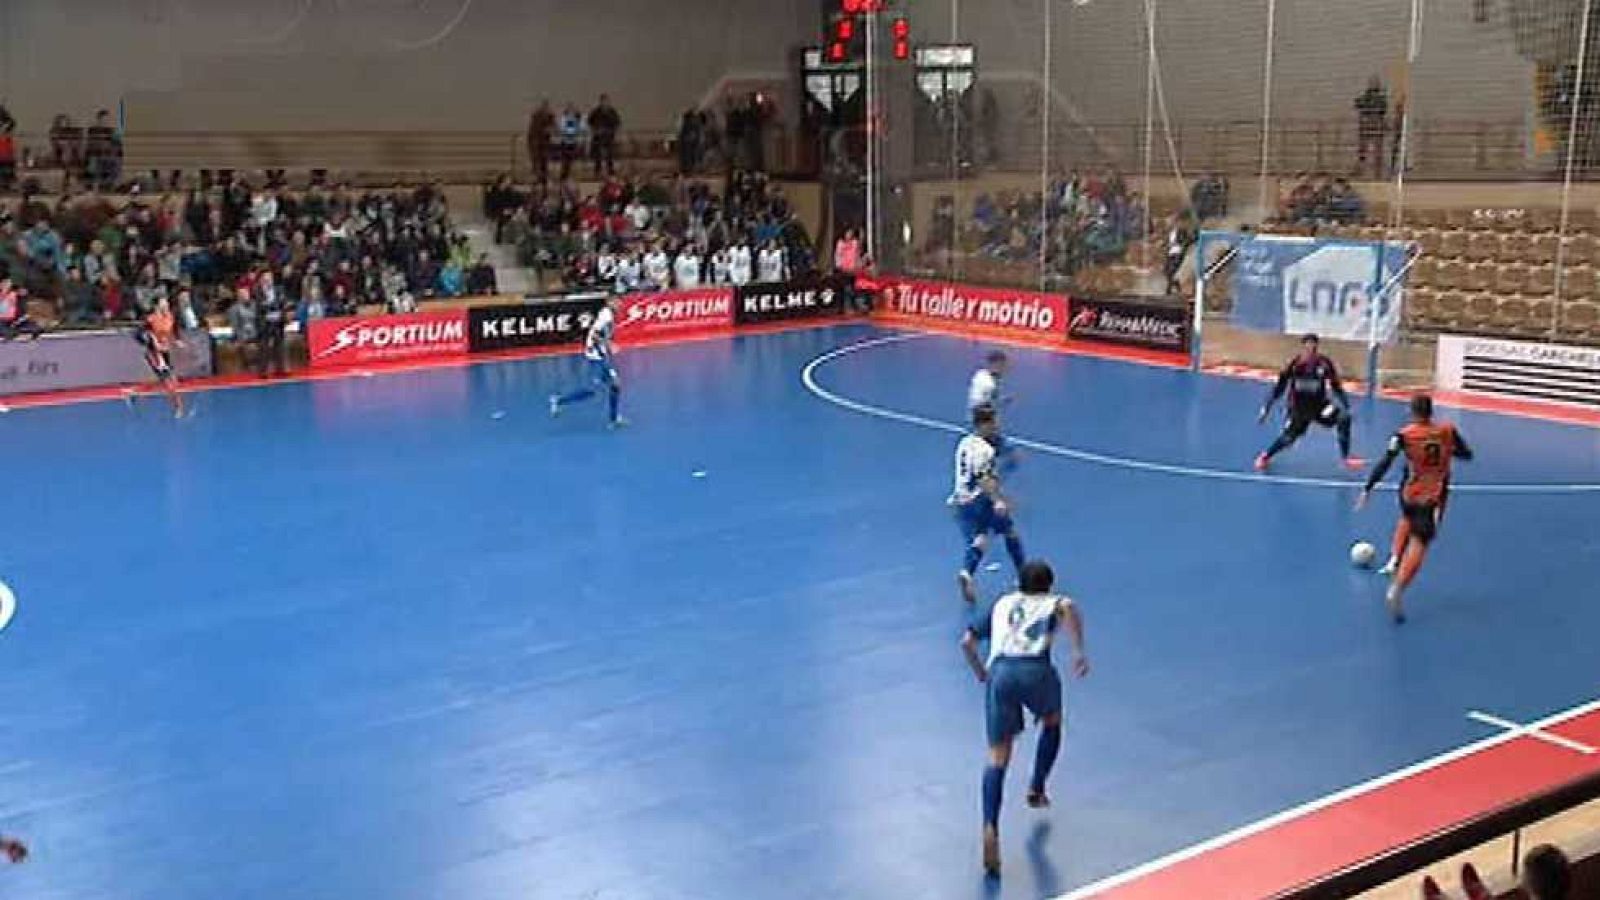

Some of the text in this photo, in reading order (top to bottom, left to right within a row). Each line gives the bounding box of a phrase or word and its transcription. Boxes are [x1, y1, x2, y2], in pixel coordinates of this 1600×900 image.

[624, 295, 729, 323] SPORTIUM
[743, 288, 817, 313] KELME
[897, 282, 1054, 329] Tu taller motrio
[325, 319, 464, 352] SPORTIUM
[481, 312, 572, 339] KELME
